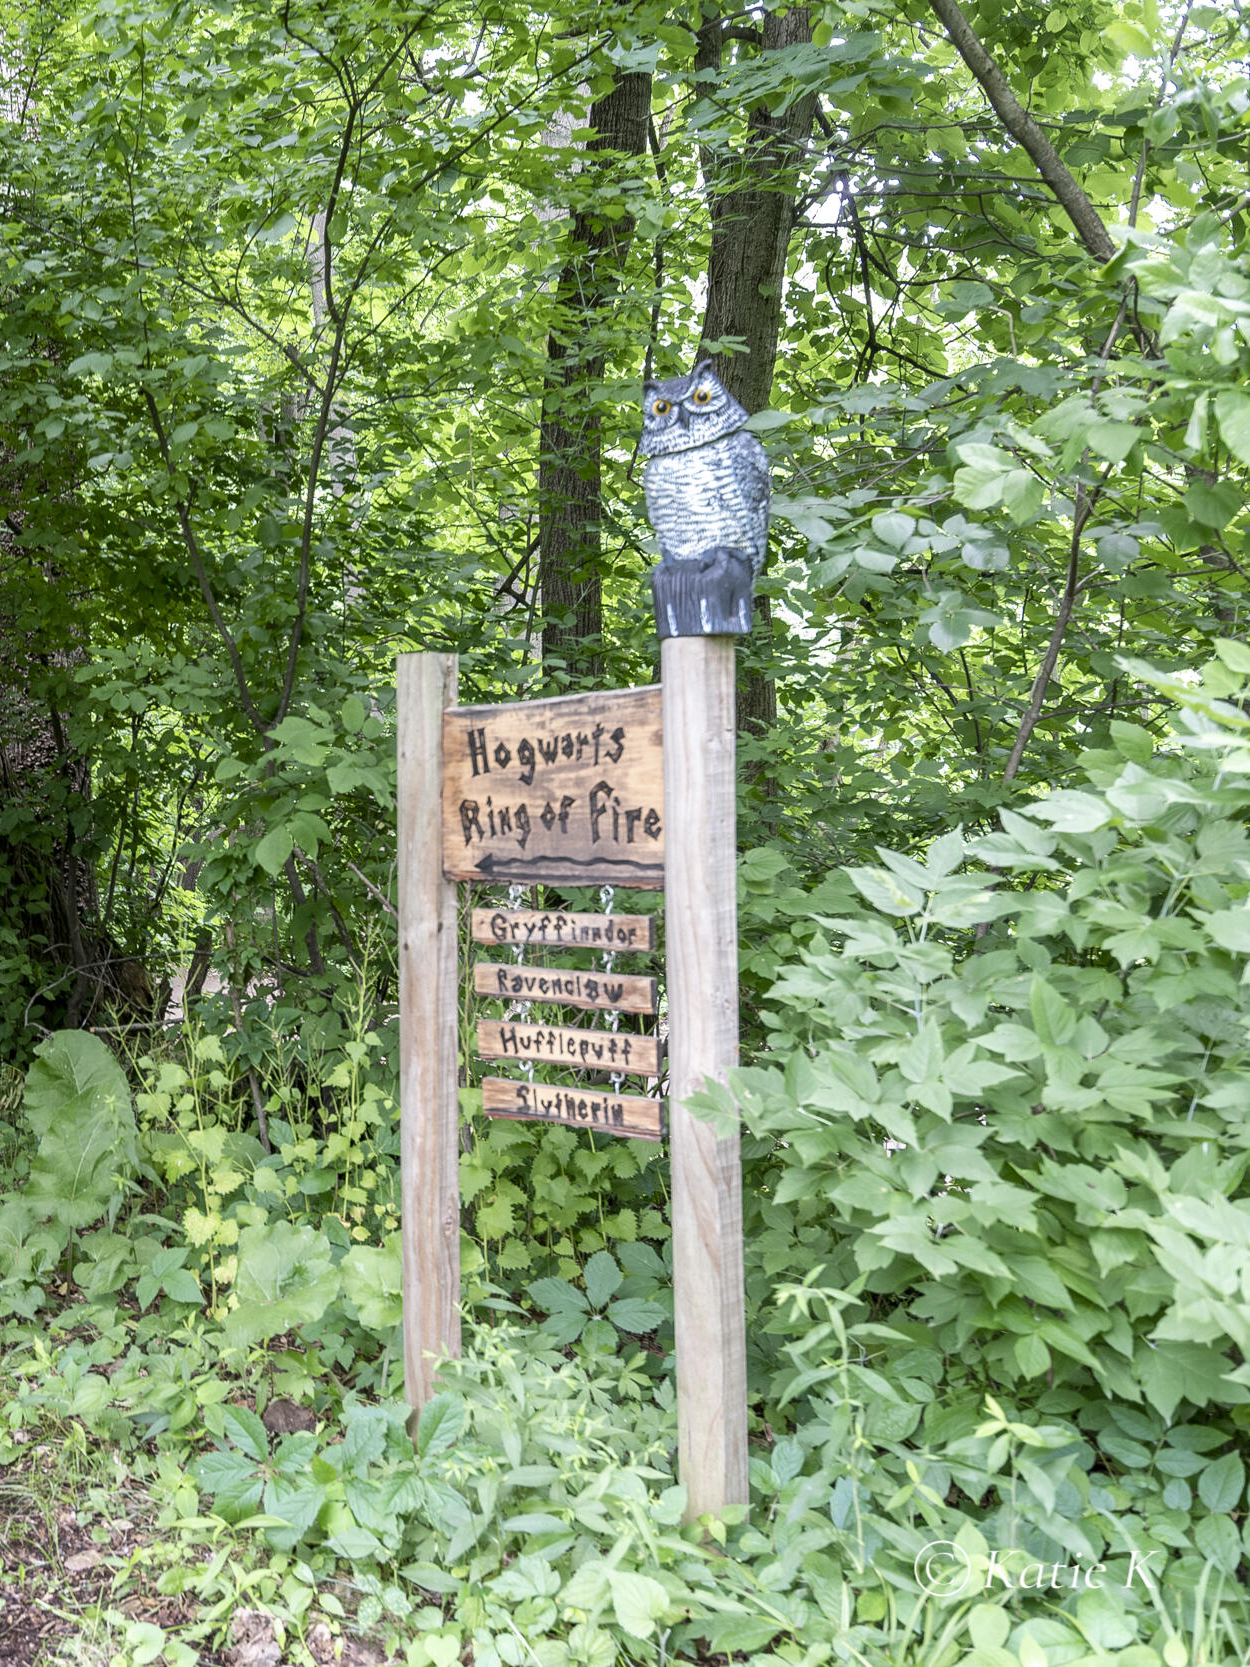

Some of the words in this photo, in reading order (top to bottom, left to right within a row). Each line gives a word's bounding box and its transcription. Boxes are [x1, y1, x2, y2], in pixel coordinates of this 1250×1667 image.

[467, 722, 626, 786] Hogwarts
[459, 795, 532, 850] Ring
[539, 795, 576, 834] of
[589, 780, 662, 846] Fire
[497, 967, 624, 1003] Ravenclaw
[500, 1026, 632, 1066] Hufflepuff
[516, 1085, 625, 1127] Slytherin
